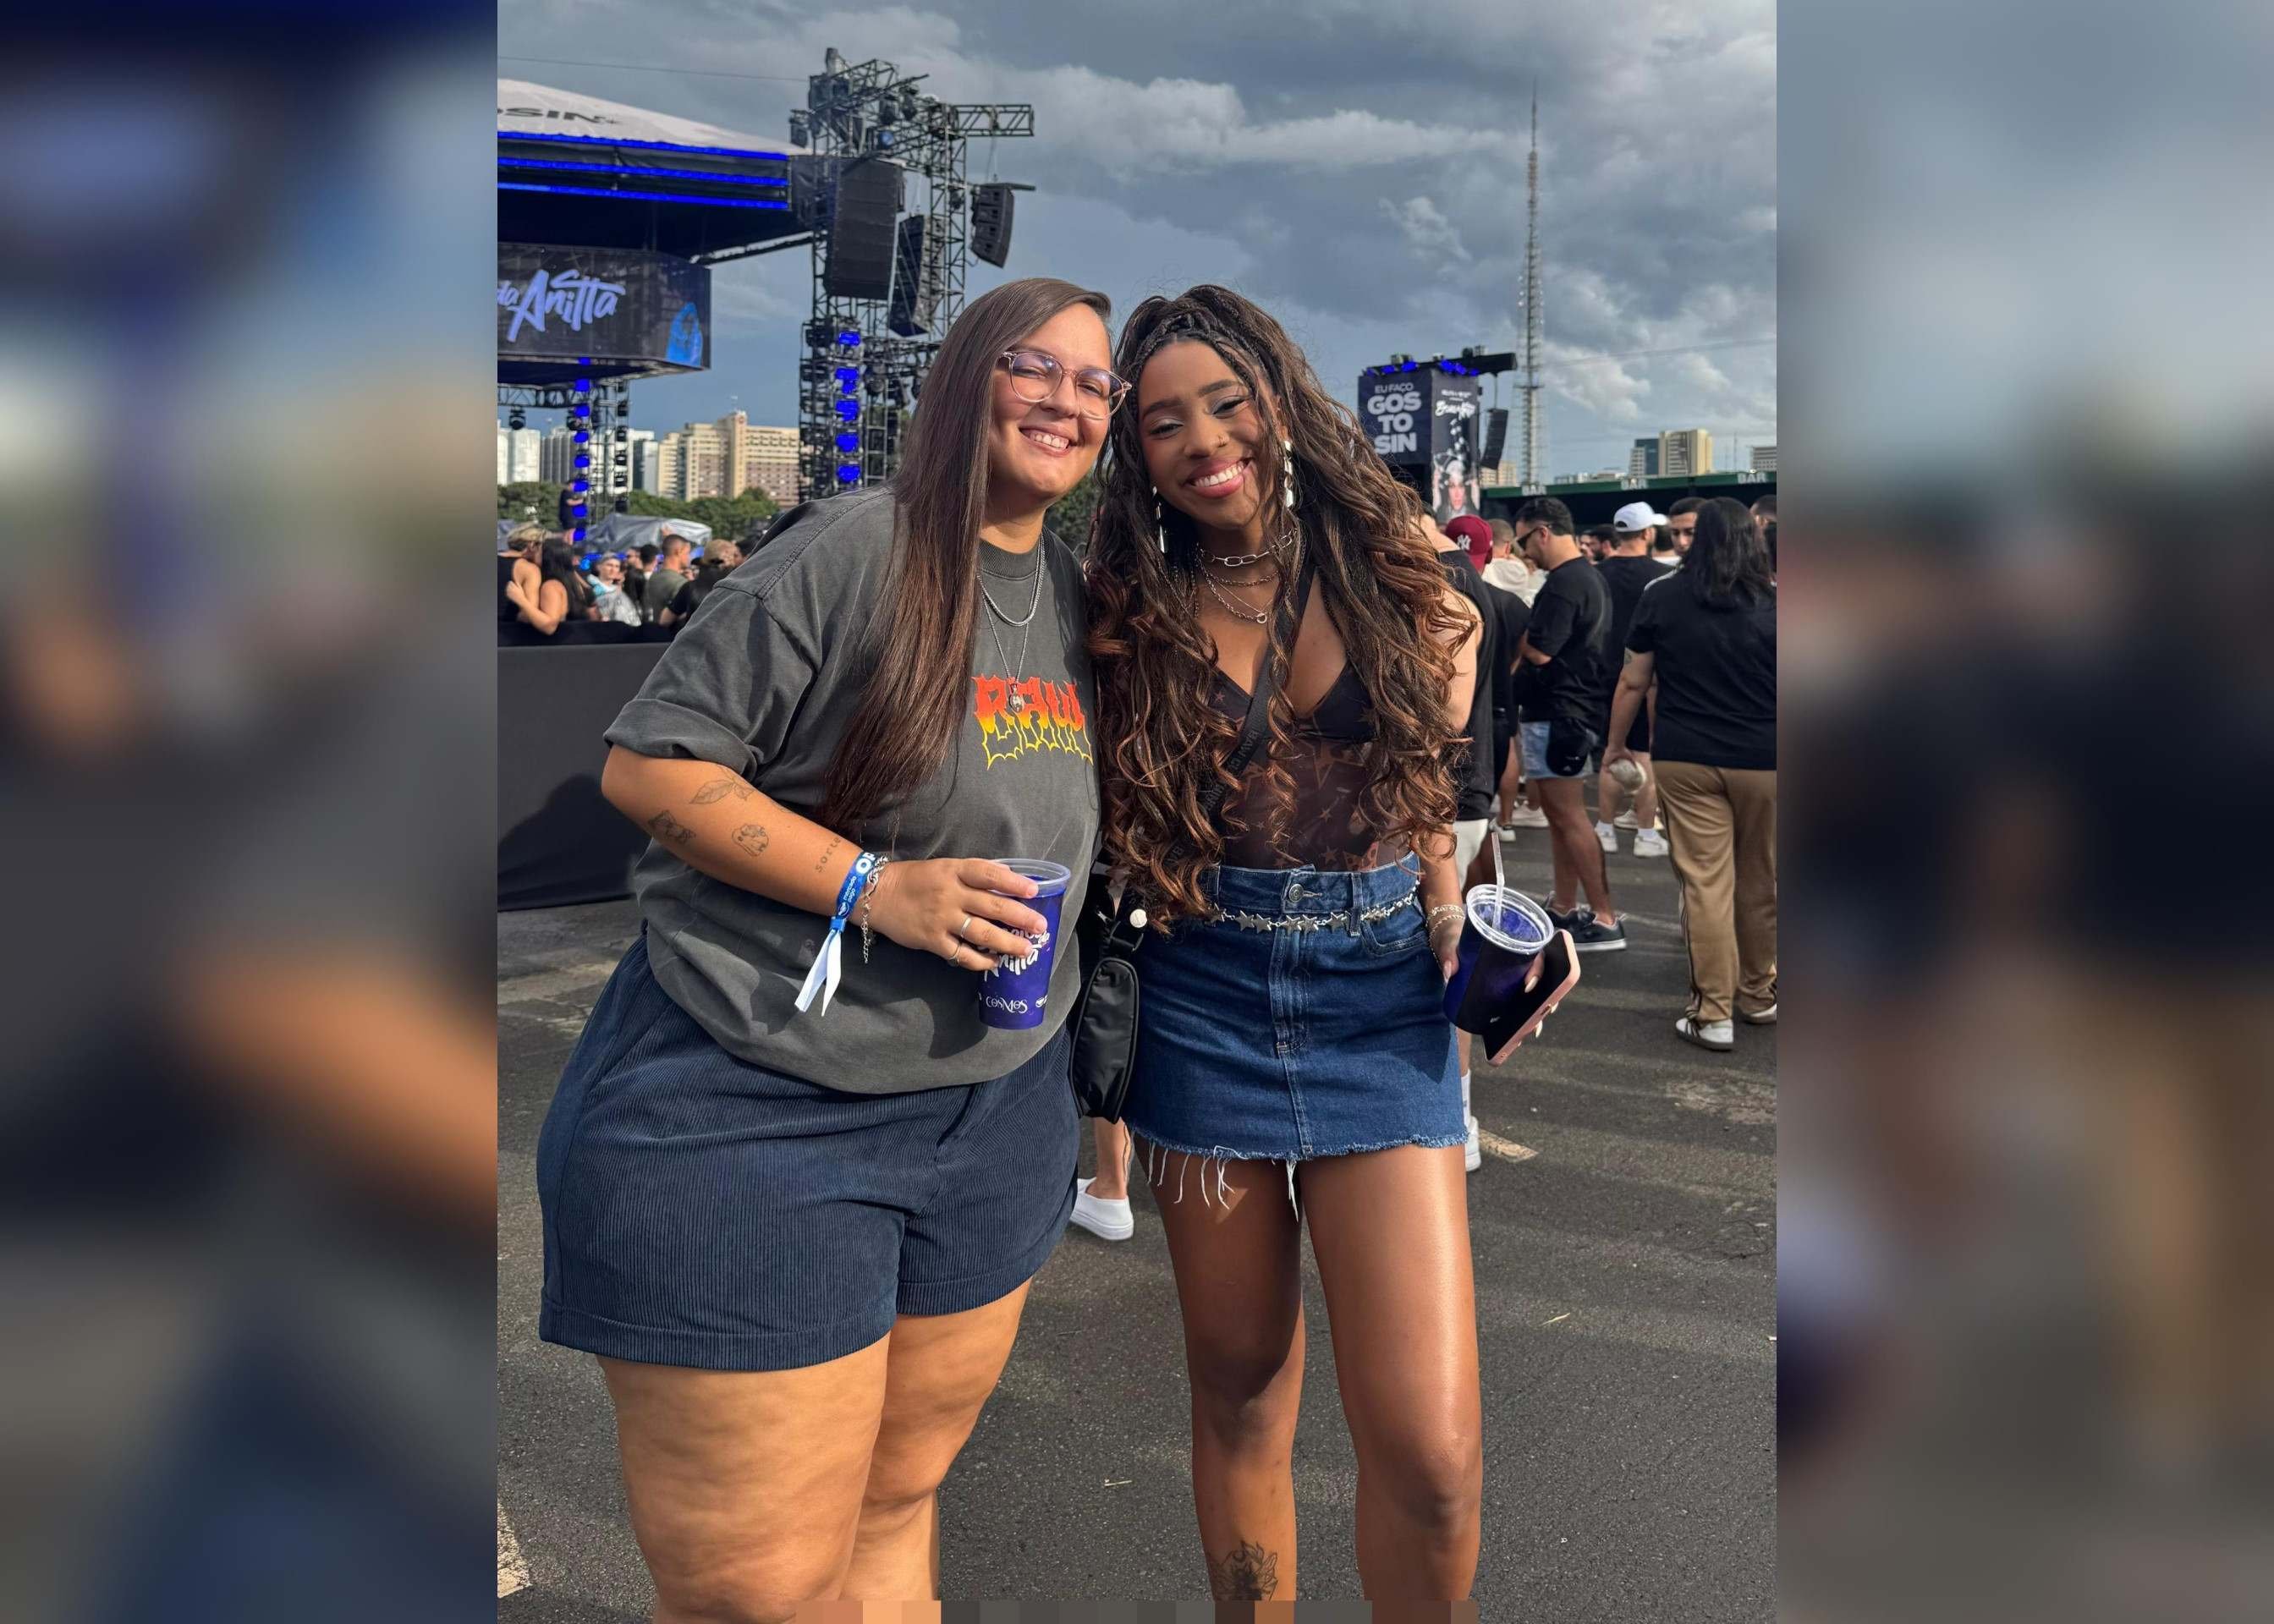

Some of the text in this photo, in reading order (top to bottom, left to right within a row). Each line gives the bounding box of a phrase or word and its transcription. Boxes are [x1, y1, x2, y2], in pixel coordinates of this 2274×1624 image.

[507, 269, 626, 343] Anitta
[1375, 385, 1387, 394] EU
[1368, 392, 1421, 414] GOS
[1377, 412, 1414, 434] TO
[1374, 432, 1417, 455] SIN
[1621, 478, 1648, 491] BAR
[1737, 471, 1766, 485] BAR
[843, 875, 857, 901] mercado
